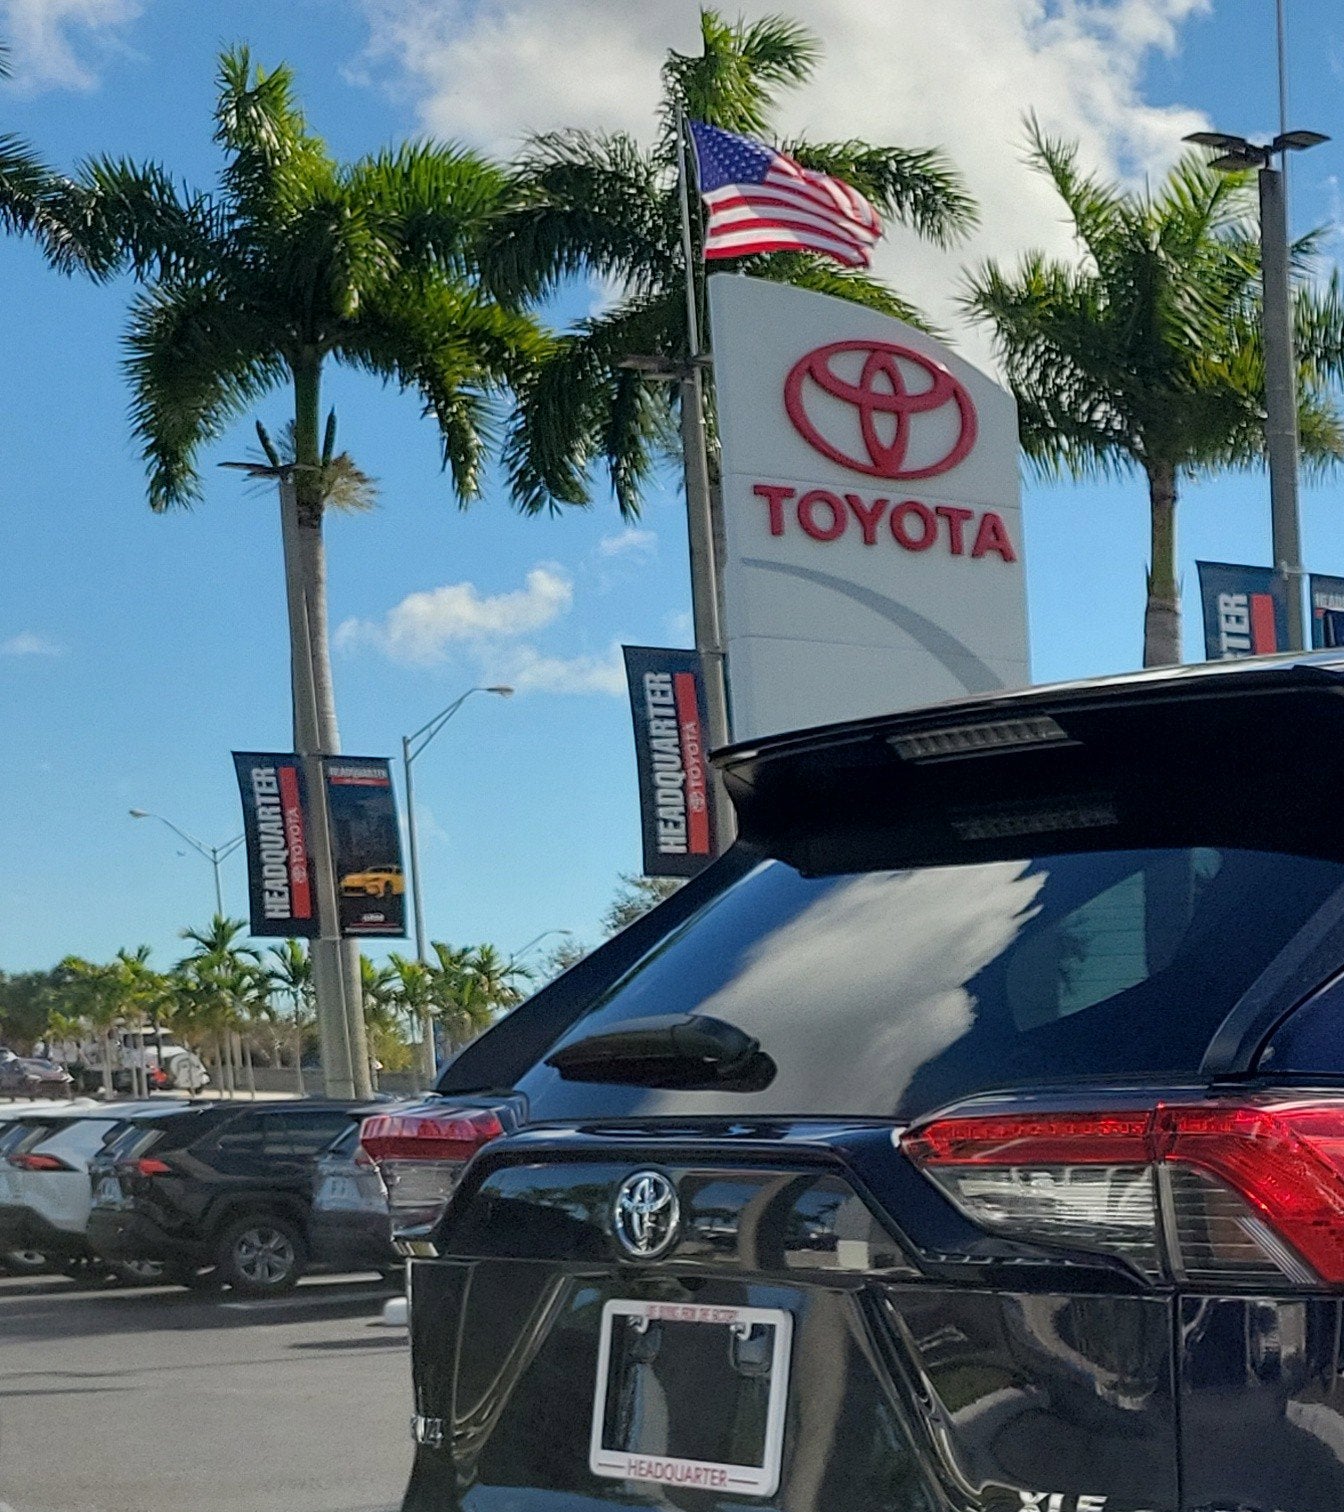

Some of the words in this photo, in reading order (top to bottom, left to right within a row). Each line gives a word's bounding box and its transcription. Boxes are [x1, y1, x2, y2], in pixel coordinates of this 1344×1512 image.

[753, 484, 1017, 562] TOYOTA
[644, 671, 687, 854] HEADQUARTER
[685, 722, 705, 792] TOYOTA
[252, 766, 291, 919] HEADQUARTER
[286, 807, 307, 867] TOYOTA
[626, 1459, 728, 1487] HEADQUARTER
